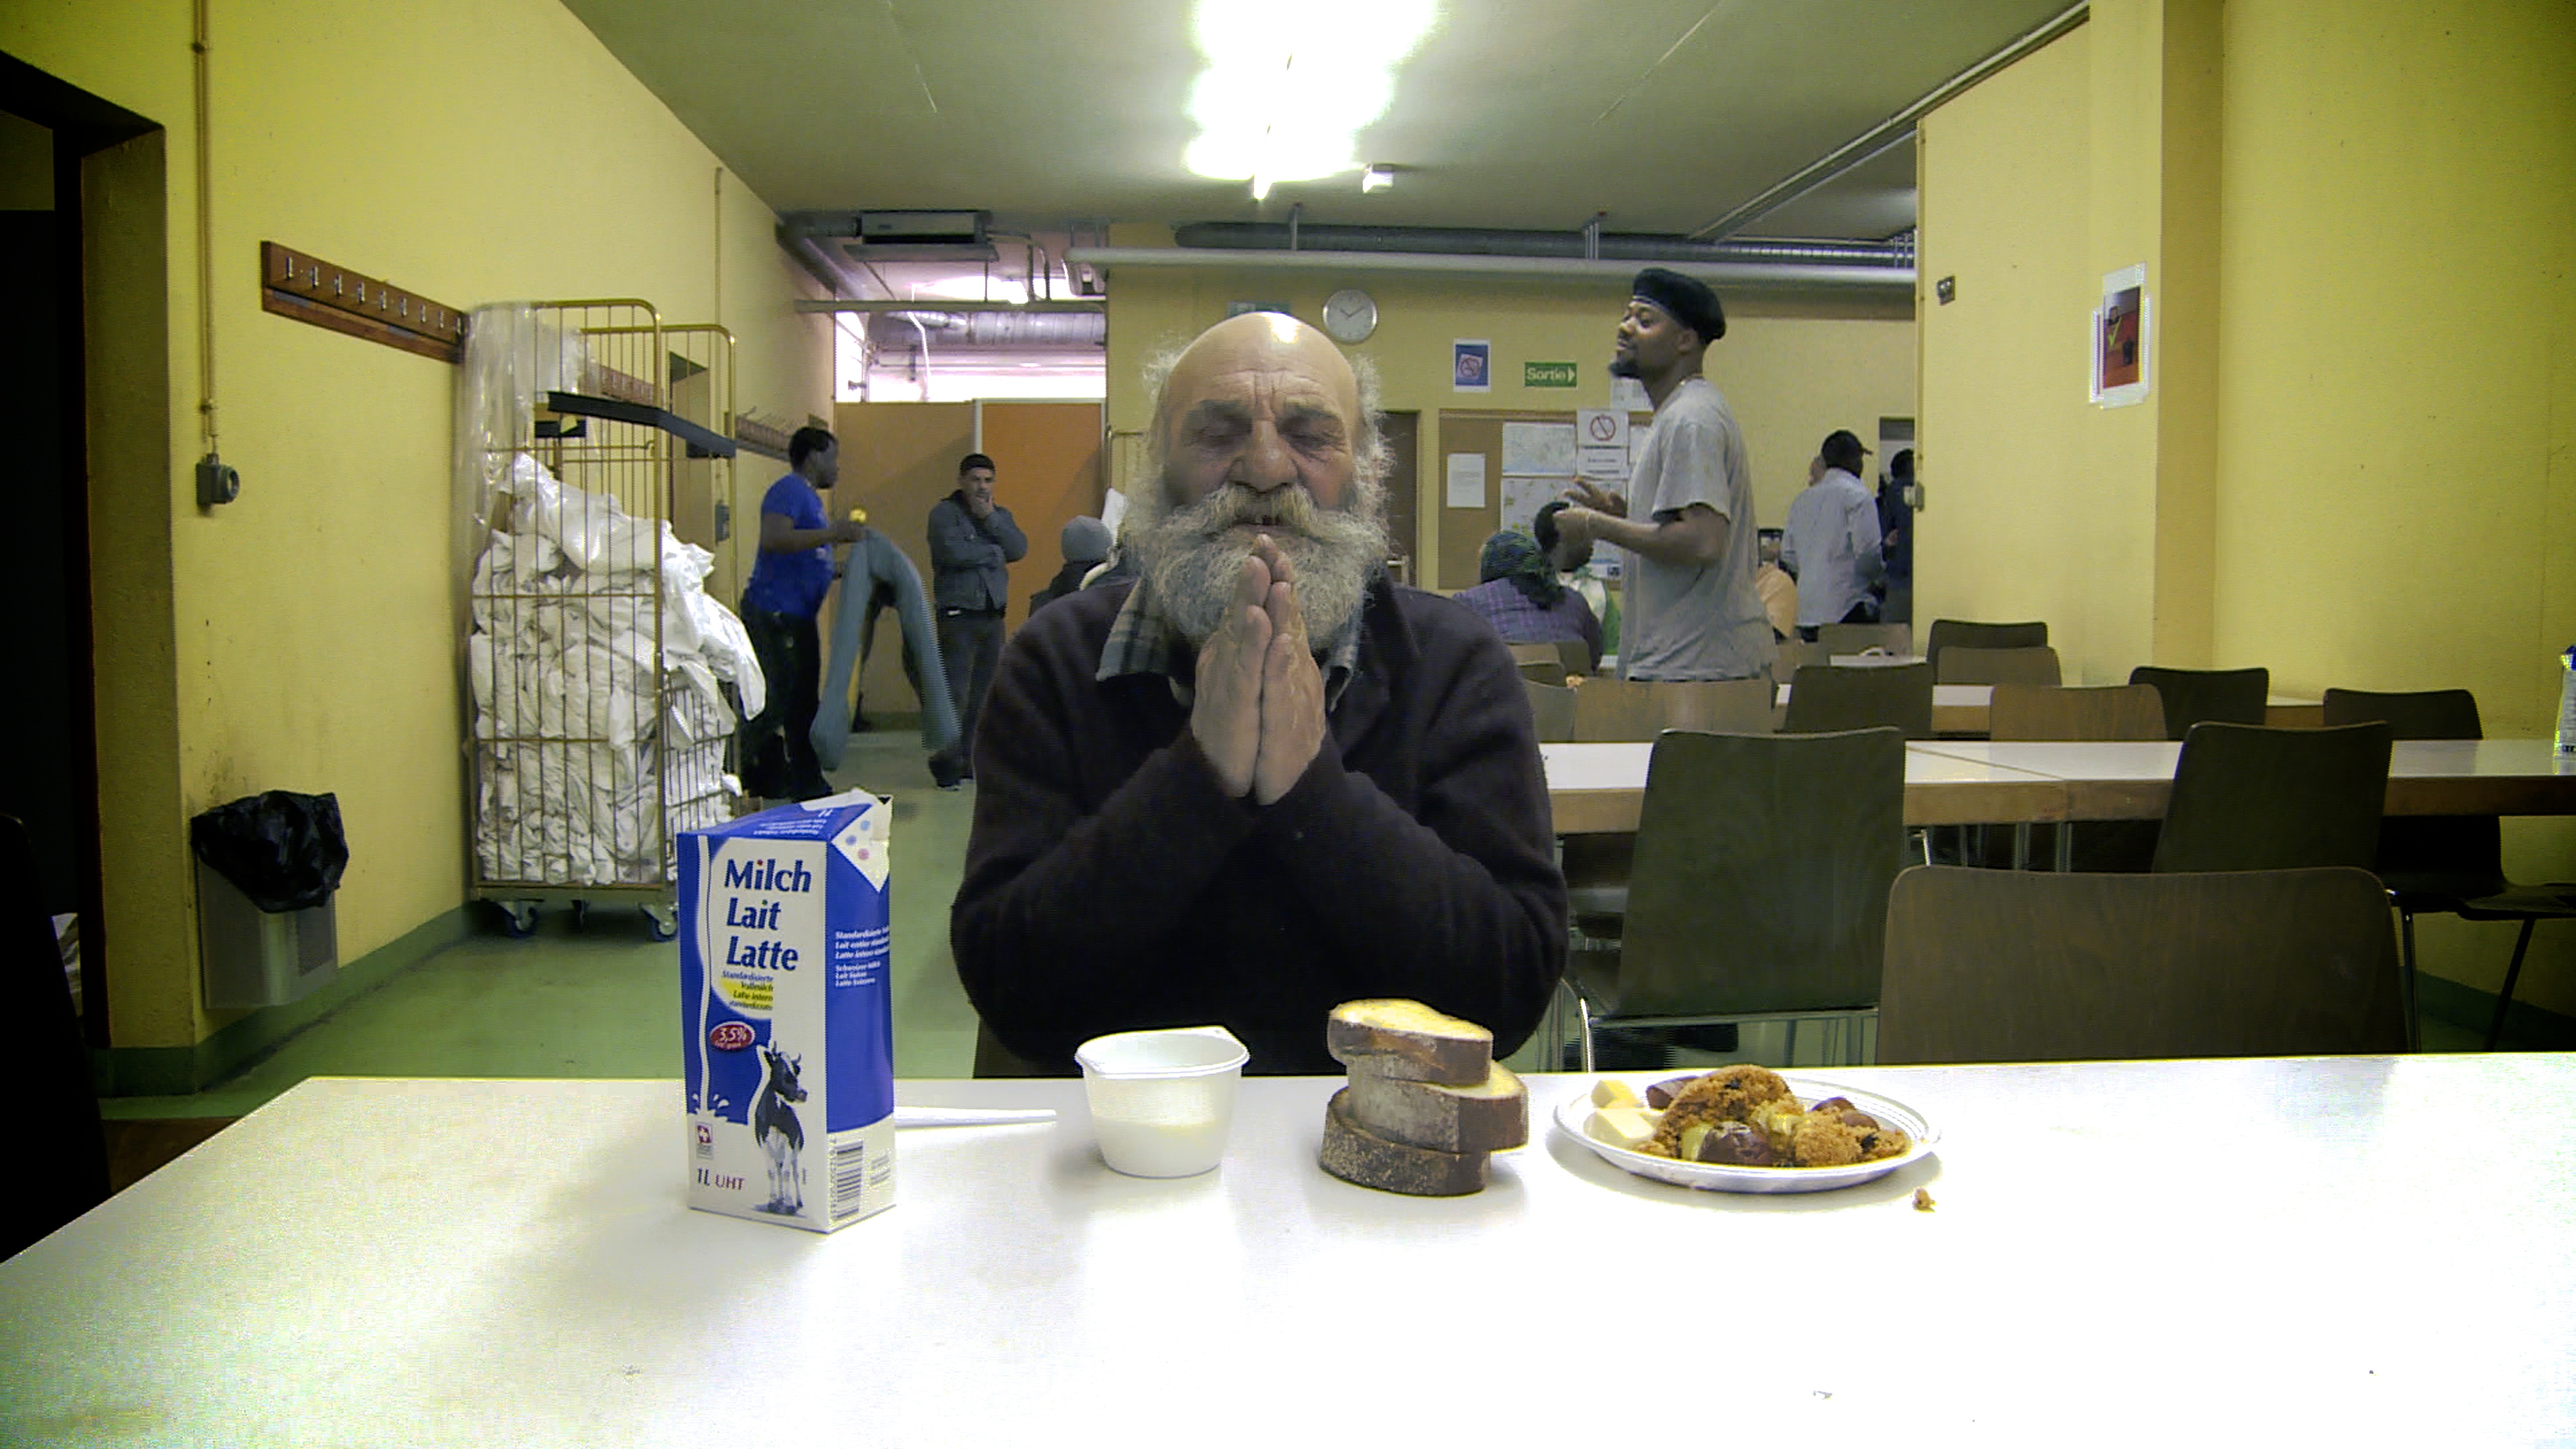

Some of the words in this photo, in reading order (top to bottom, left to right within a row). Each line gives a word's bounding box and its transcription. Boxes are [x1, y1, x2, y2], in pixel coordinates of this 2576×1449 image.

[1526, 367, 1566, 381] Sortie
[724, 859, 811, 893] Milch
[726, 897, 781, 931] Lait
[726, 936, 798, 971] Latte
[719, 1027, 747, 1042] 3,5%
[697, 1168, 710, 1186] 1L
[715, 1174, 744, 1190] UHT
